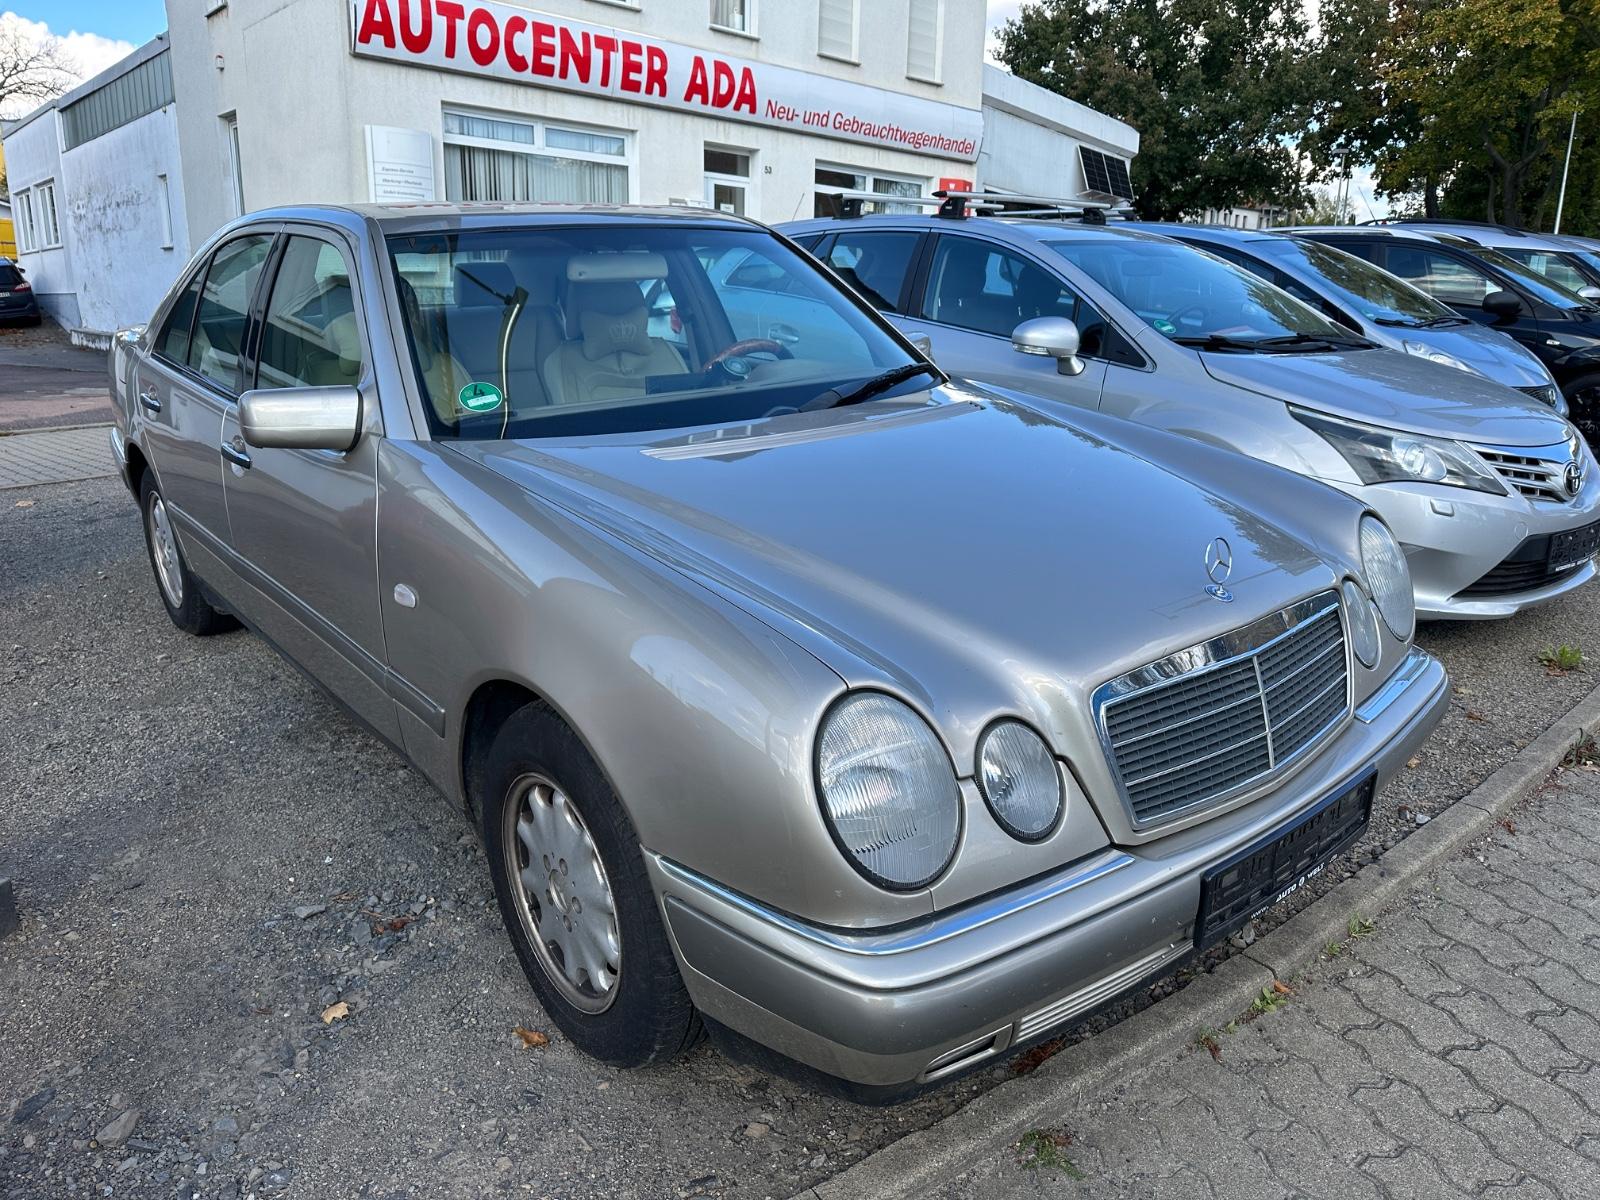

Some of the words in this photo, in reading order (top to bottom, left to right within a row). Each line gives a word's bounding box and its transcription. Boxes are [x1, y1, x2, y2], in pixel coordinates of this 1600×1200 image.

[358, 0, 668, 98] AUTOCENTER
[684, 55, 757, 115] ADA
[765, 99, 799, 121] Neu-
[803, 110, 830, 128] und
[833, 112, 976, 155] Gebrauchtwagenhandel
[764, 165, 772, 174] 53
[473, 384, 485, 396] 4
[1275, 883, 1297, 903] AUTO
[1307, 862, 1324, 879] WELT
